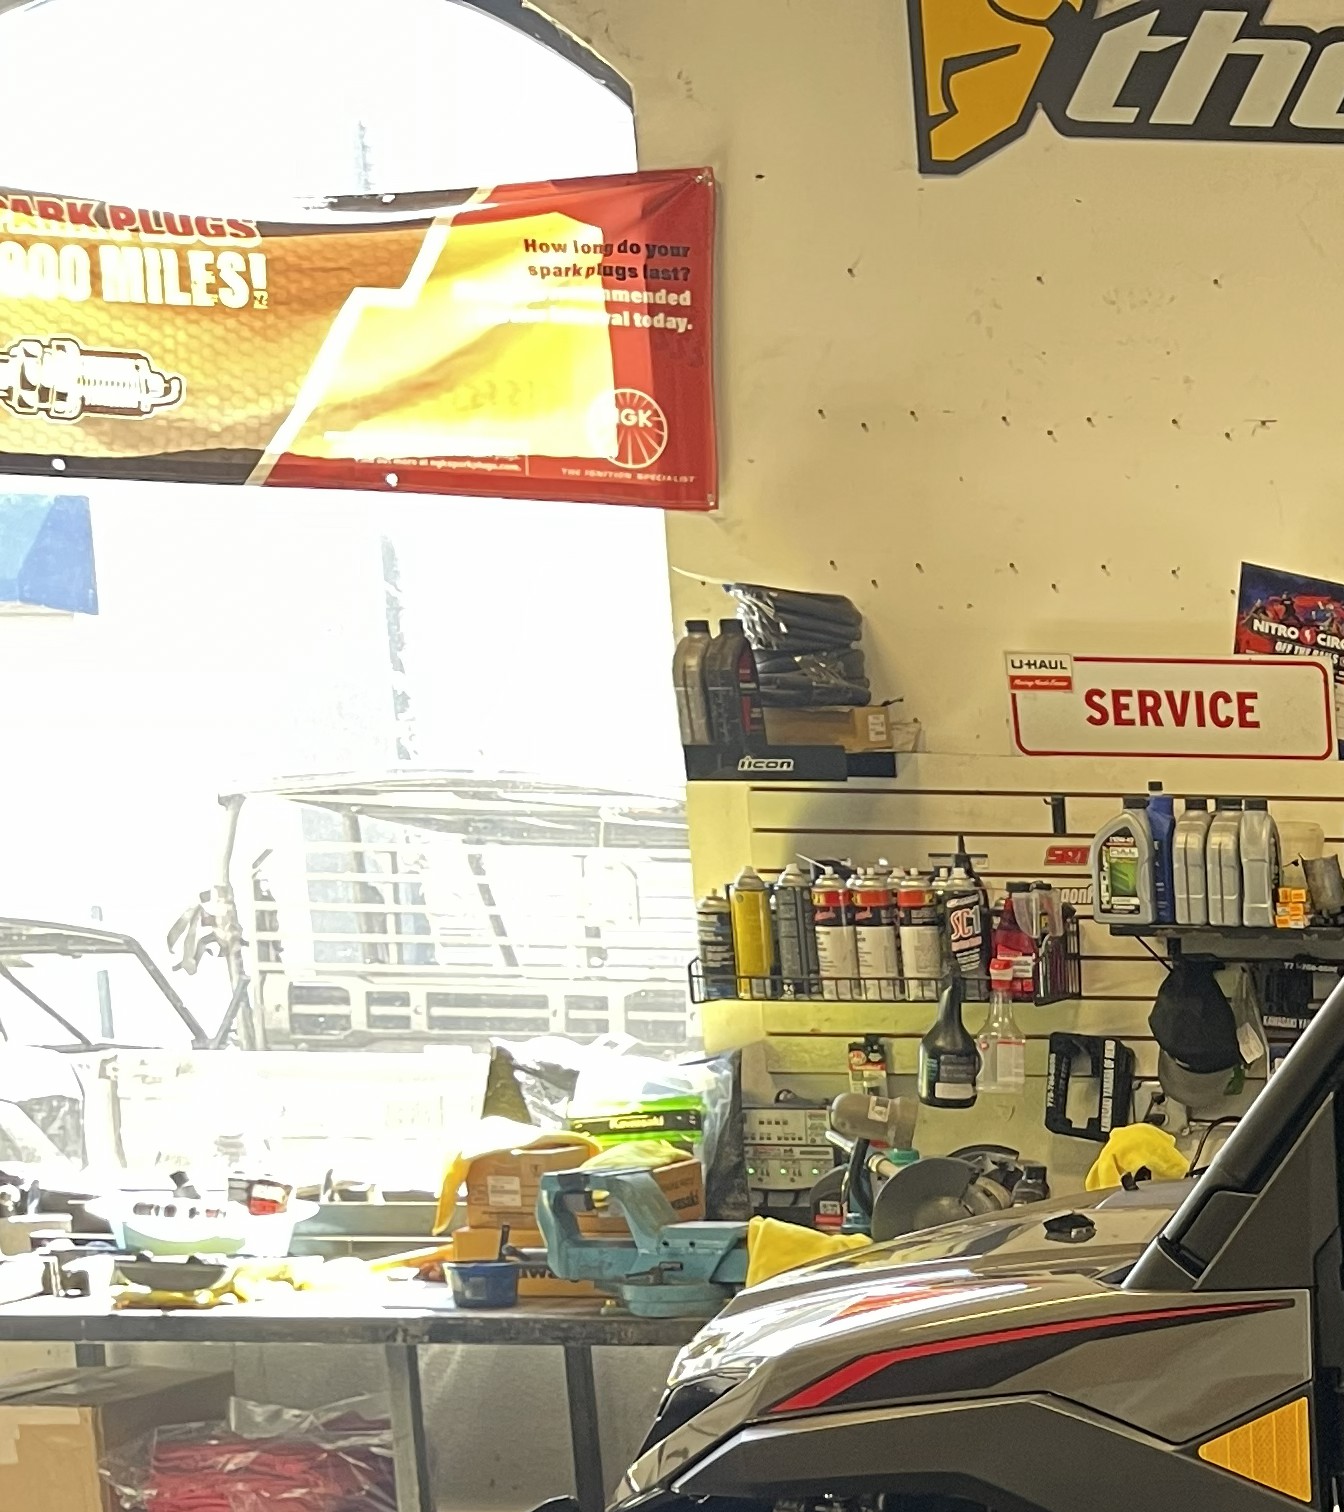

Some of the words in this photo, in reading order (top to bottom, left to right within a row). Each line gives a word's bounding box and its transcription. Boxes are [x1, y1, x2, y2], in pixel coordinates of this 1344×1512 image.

[107, 204, 259, 239] PLUGS
[524, 238, 568, 254] How
[573, 239, 614, 257] long
[616, 238, 642, 254] do
[645, 241, 691, 258] your
[528, 263, 583, 280] spark
[585, 263, 639, 281] plugs
[642, 263, 691, 281] last?
[633, 313, 694, 333] today.
[561, 467, 581, 477] THE
[1252, 618, 1300, 640] NITRO
[1010, 658, 1068, 670] U-HAUL
[1084, 687, 1261, 729] SERVICE
